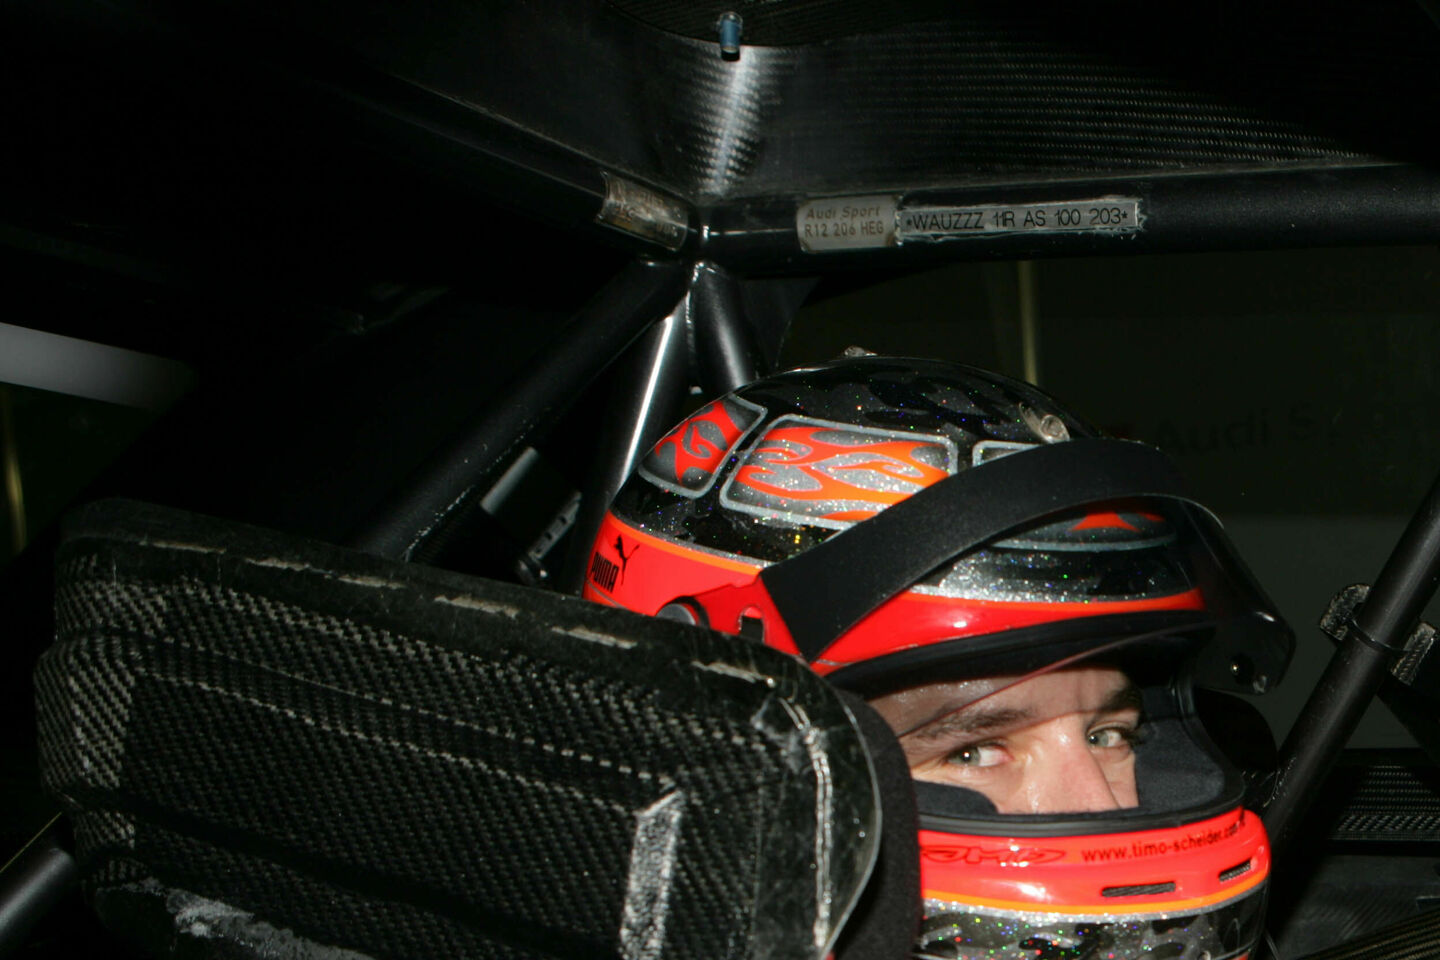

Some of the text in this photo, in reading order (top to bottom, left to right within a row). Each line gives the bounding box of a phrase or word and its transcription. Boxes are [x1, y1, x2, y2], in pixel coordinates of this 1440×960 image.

[806, 206, 880, 220] Audi Sport
[1023, 209, 1046, 227] AS
[1055, 208, 1081, 226] 100
[805, 223, 828, 237] R12
[591, 551, 620, 594] PUMA
